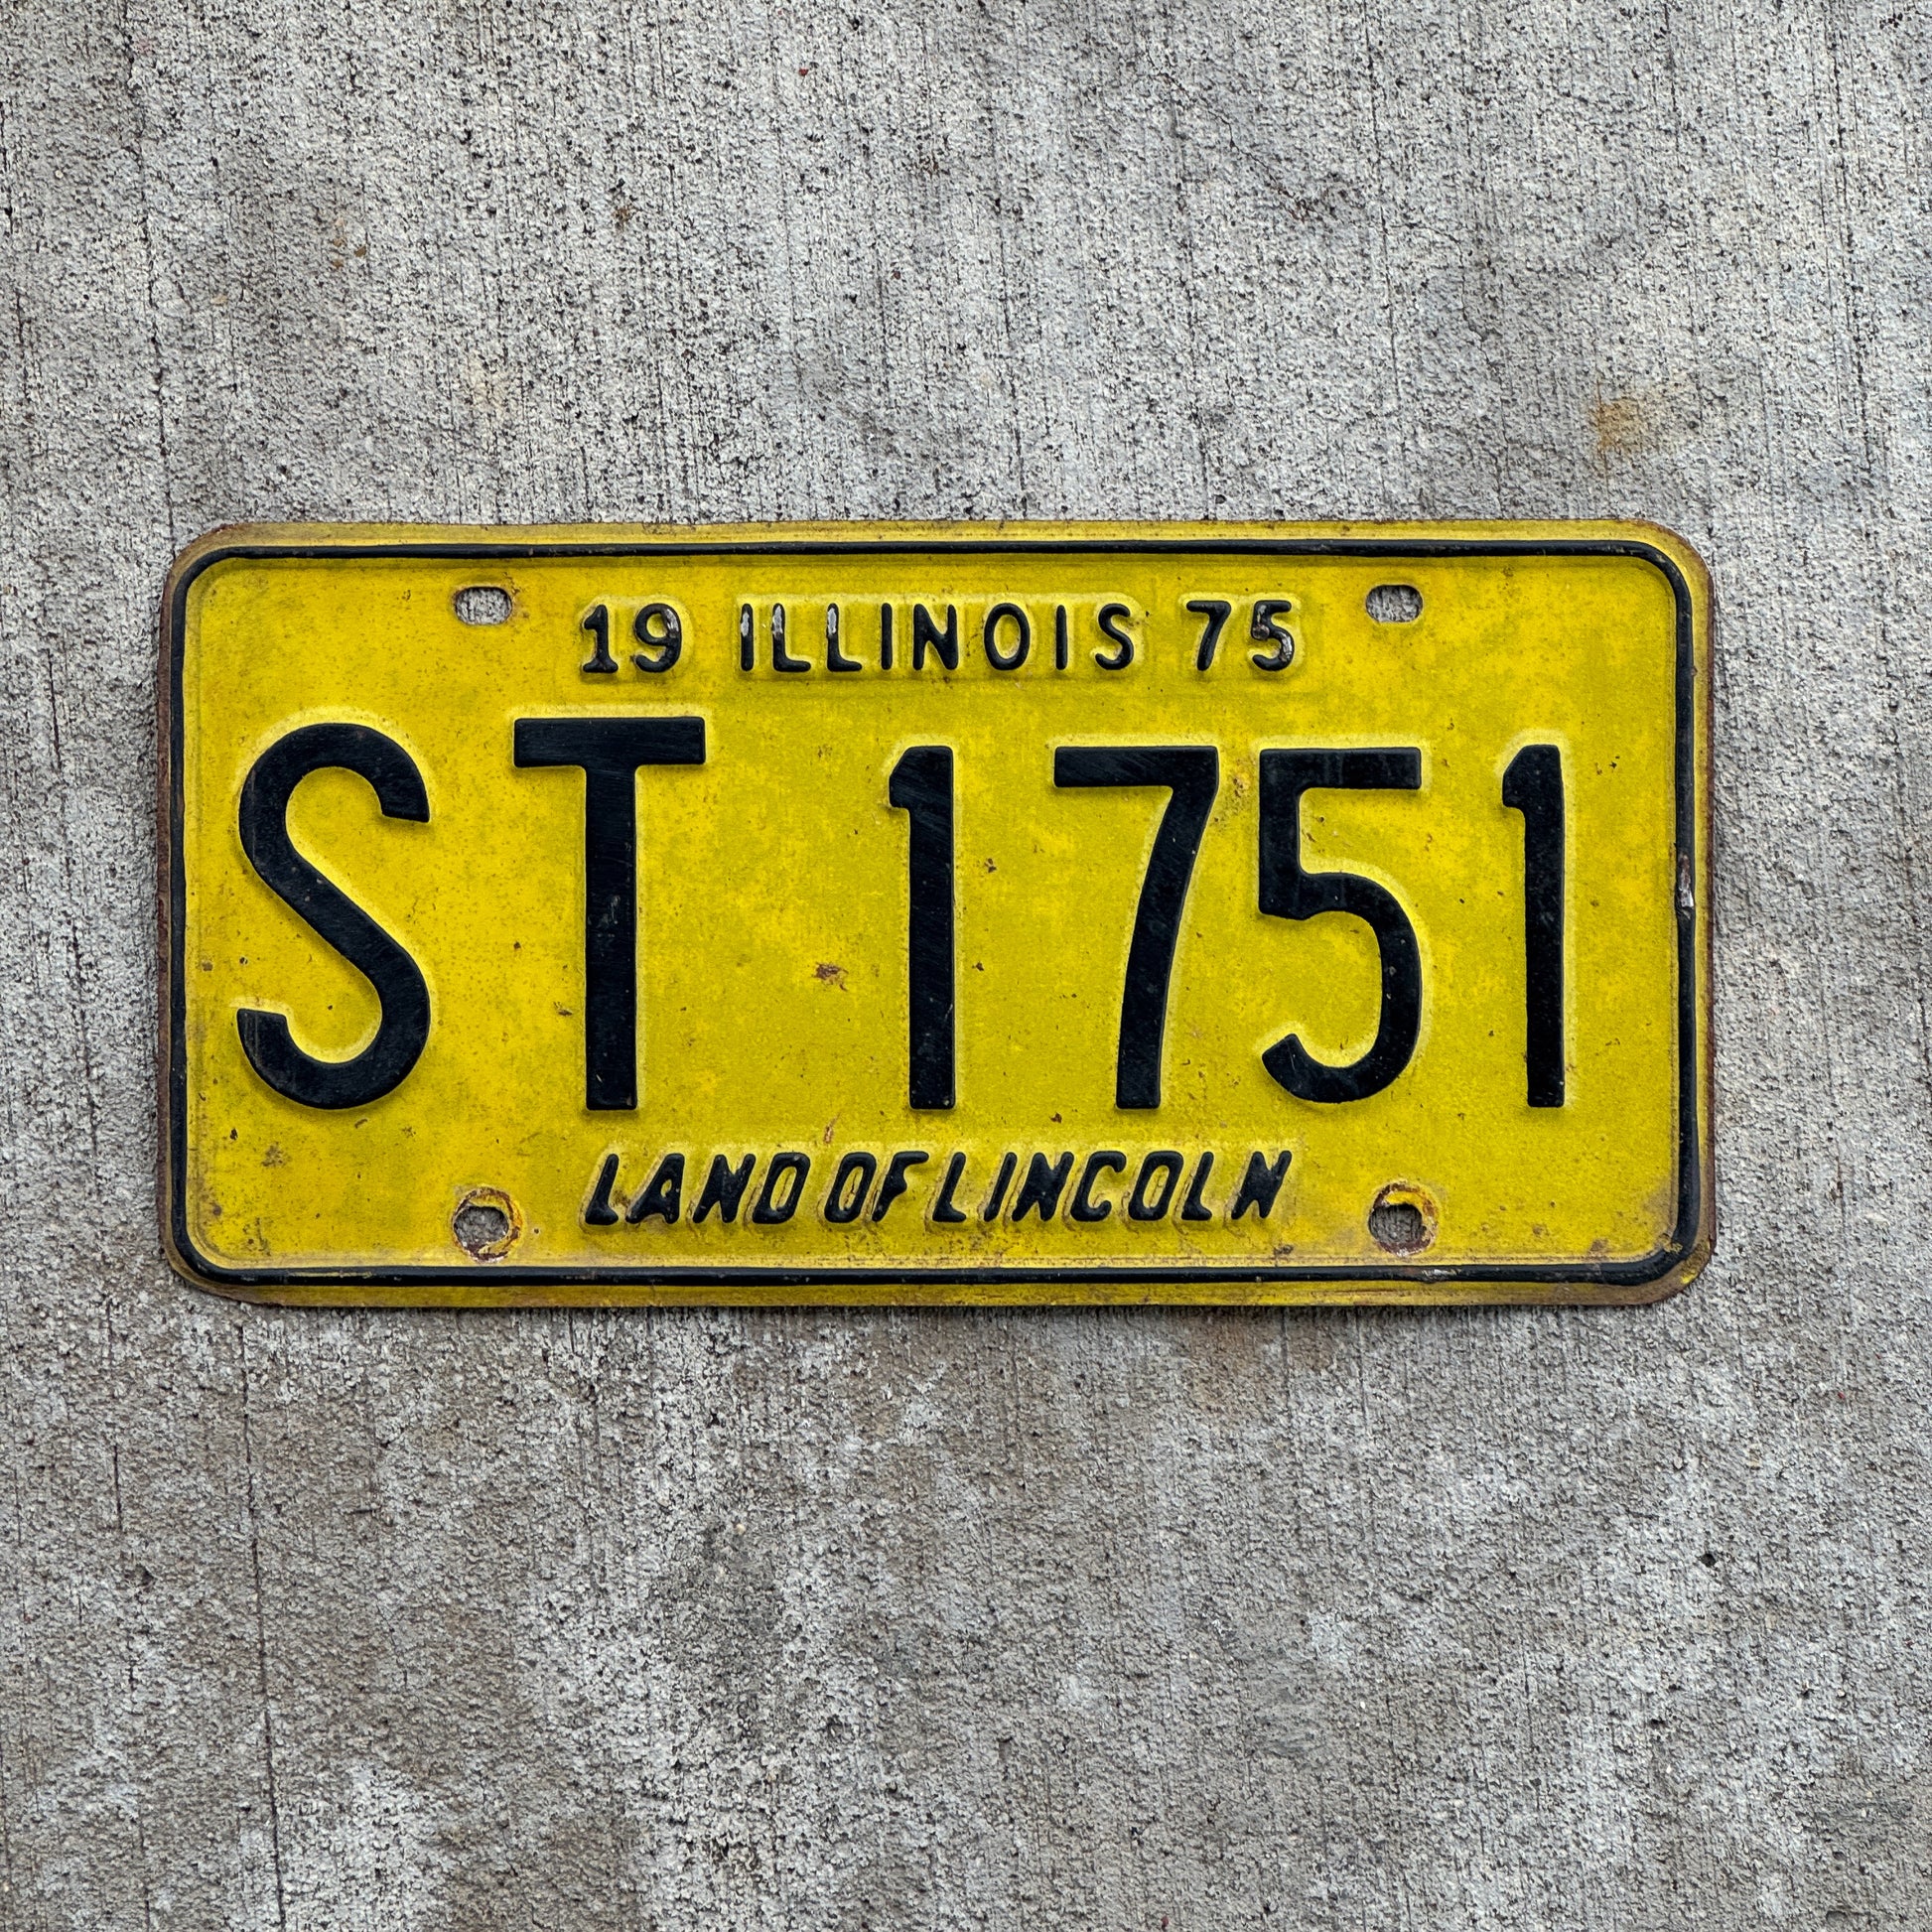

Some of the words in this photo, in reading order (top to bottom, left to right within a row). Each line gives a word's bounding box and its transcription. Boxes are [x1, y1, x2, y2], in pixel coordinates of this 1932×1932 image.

[582, 602, 682, 675] 19
[739, 601, 1134, 674] ILLINOIS
[1185, 601, 1296, 672] 75
[237, 716, 706, 1111] ST
[889, 745, 1566, 1111] 1751
[584, 1152, 812, 1227] LAND
[823, 1151, 930, 1225] OF
[931, 1150, 1294, 1225] LINCOLN
